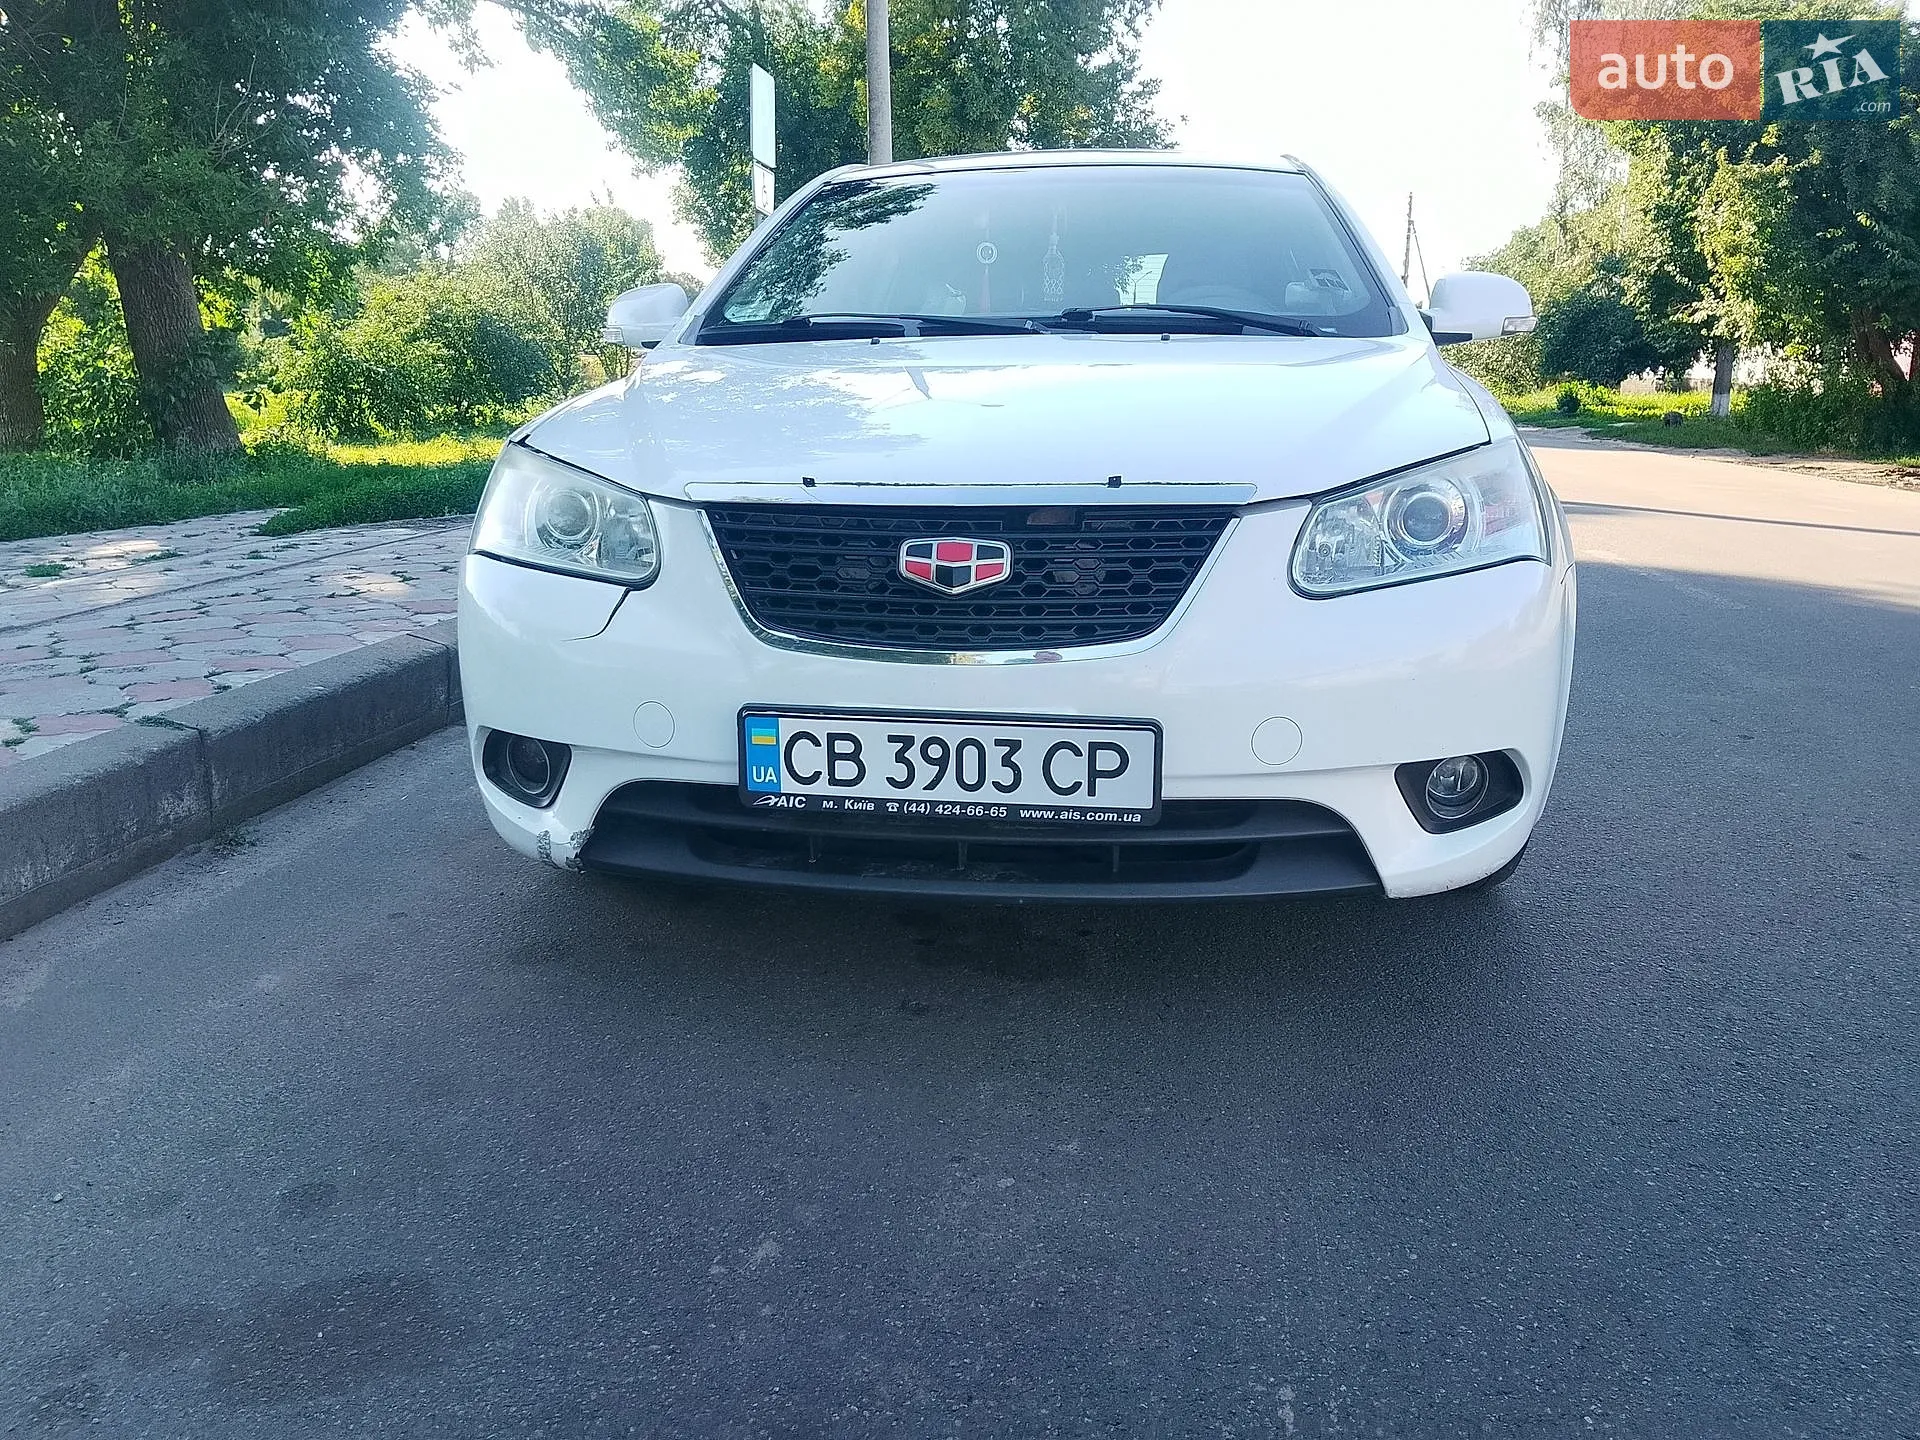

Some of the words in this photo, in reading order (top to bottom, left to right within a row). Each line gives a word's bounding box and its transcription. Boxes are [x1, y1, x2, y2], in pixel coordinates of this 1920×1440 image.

[752, 766, 777, 783] UA
[784, 731, 866, 787] CB
[886, 735, 1022, 793] 3903
[1042, 741, 1130, 797] CP
[822, 800, 838, 809] м.
[844, 799, 875, 811] Київ
[904, 801, 931, 815] (44)
[935, 804, 1008, 818] 424-66-65
[1019, 808, 1142, 822] www.ais.com.ua
